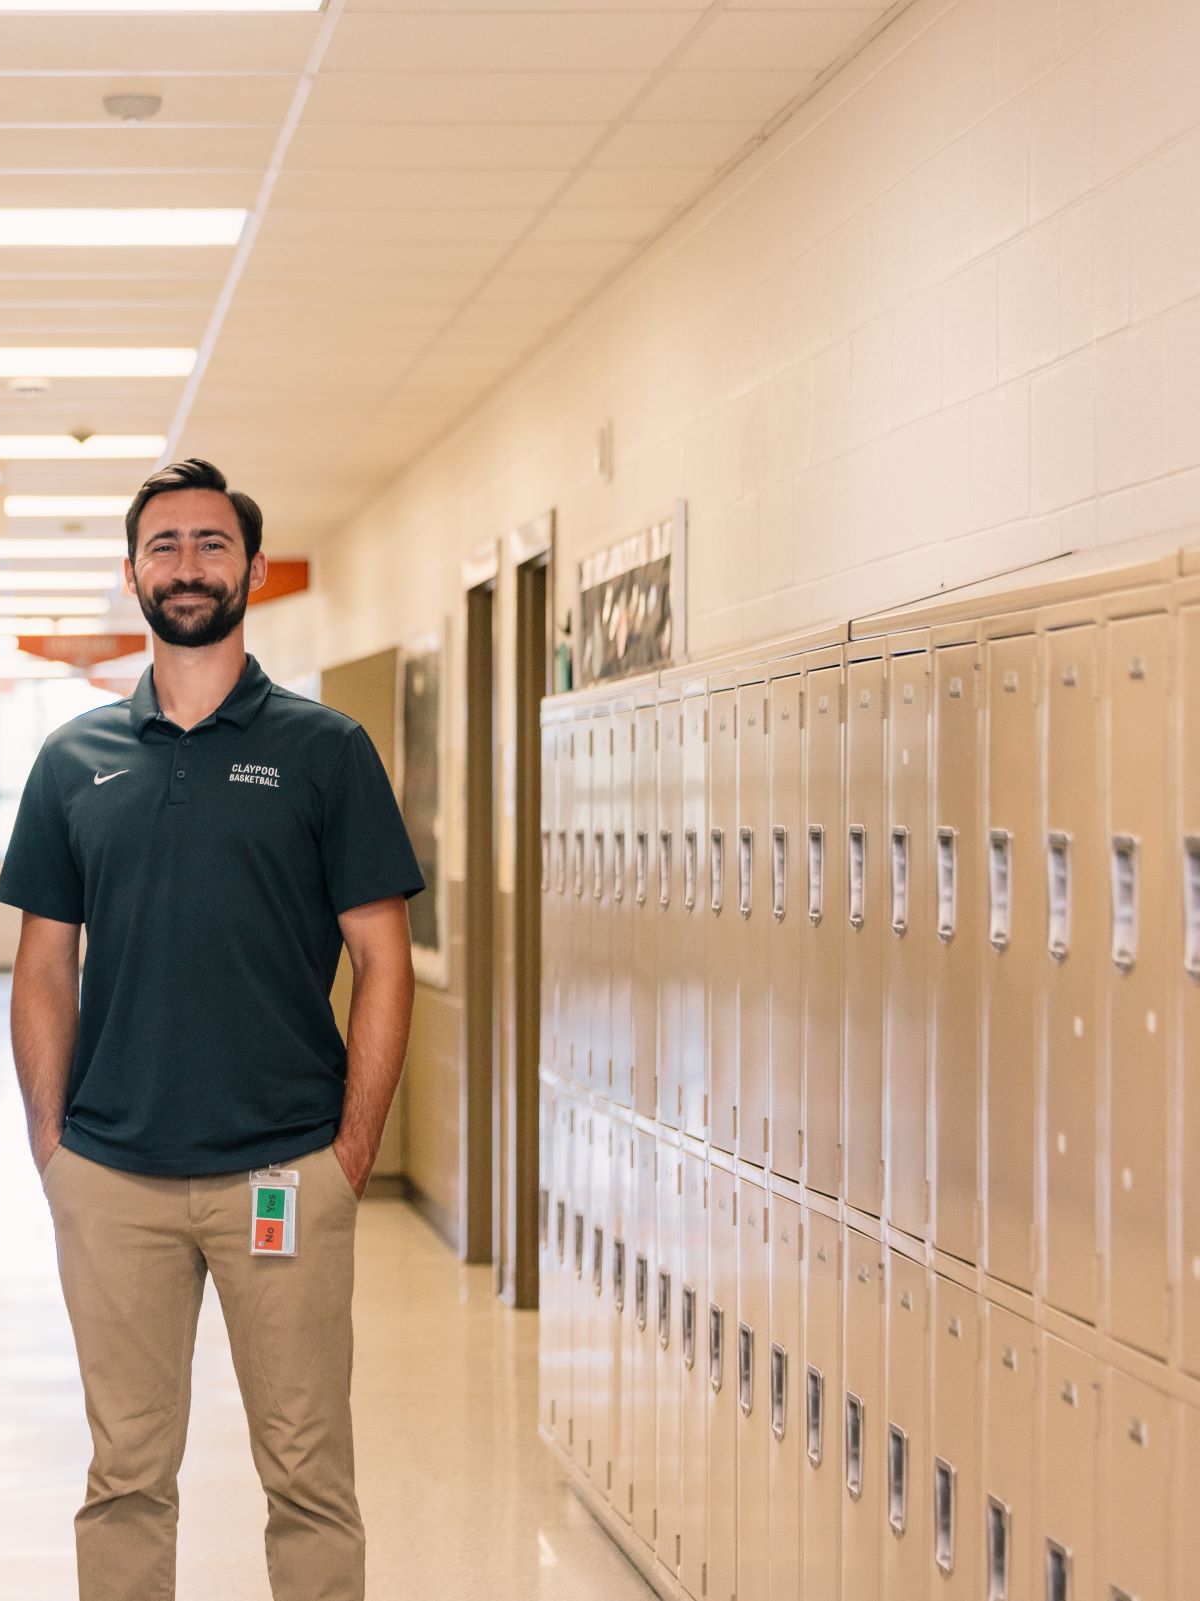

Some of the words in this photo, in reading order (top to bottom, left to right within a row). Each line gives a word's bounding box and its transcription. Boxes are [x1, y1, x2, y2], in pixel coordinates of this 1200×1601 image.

[231, 764, 280, 777] CLAYPOOL
[229, 774, 279, 787] BASKETBALL
[266, 1194, 276, 1213] Yes
[266, 1227, 274, 1243] No
